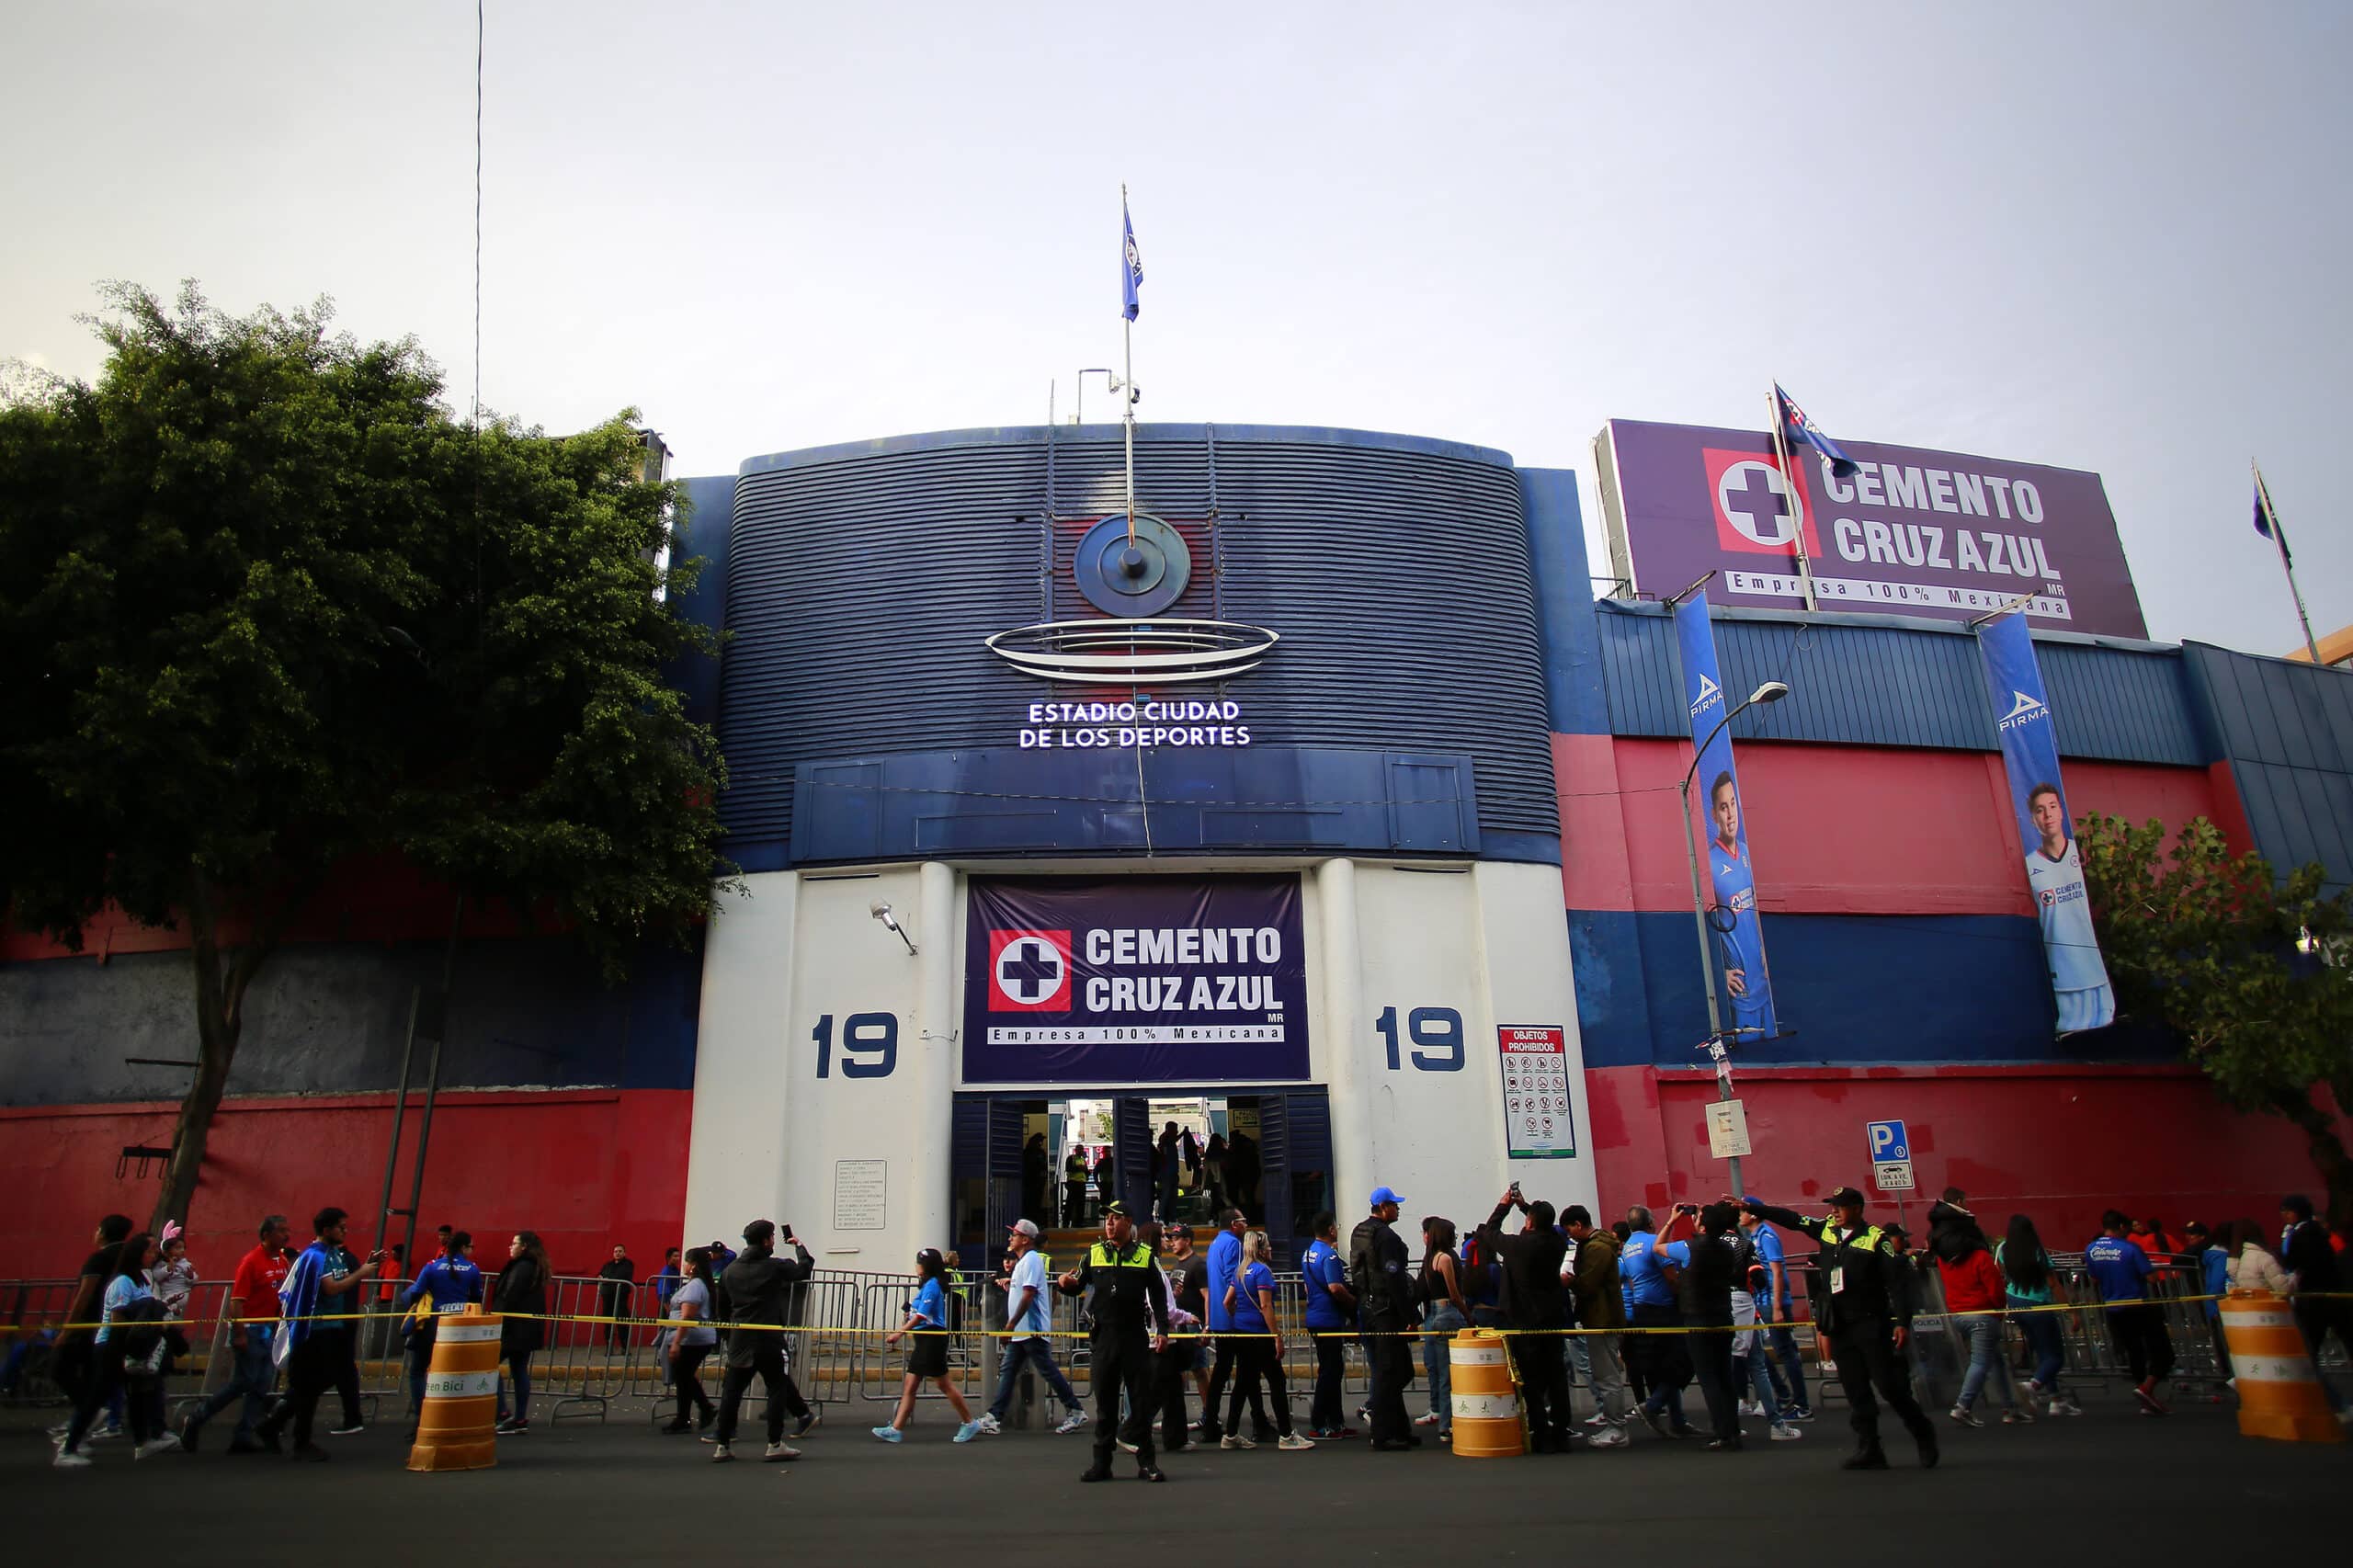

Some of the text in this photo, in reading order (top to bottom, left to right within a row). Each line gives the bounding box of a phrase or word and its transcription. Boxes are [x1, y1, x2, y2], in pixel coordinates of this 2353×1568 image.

[1821, 461, 2044, 524] CEMENTO
[1833, 517, 2062, 580] CRUZ AZUL
[1733, 574, 1847, 596] Emprsa
[1866, 581, 1929, 602] 100%
[2046, 583, 2066, 597] MR
[1029, 701, 1240, 723] ESTADIO CIUDAD
[1690, 691, 1724, 719] PIRMA
[1999, 707, 2049, 733] PIRMA
[1019, 726, 1251, 748] DE LOS DEPORTES
[1086, 926, 1281, 965] CEMENTO
[1086, 975, 1284, 1013] CRUZ AZUL
[1267, 1013, 1284, 1023] MR
[812, 1012, 899, 1079] 19
[994, 1027, 1279, 1042] Empresa 100% Mexicana
[1375, 1006, 1466, 1072] 19
[1508, 1042, 1555, 1052] PROHIBIDOS
[1513, 1030, 1548, 1040] OBJETOS
[1870, 1124, 1893, 1153] P
[442, 1380, 465, 1392] Bici
